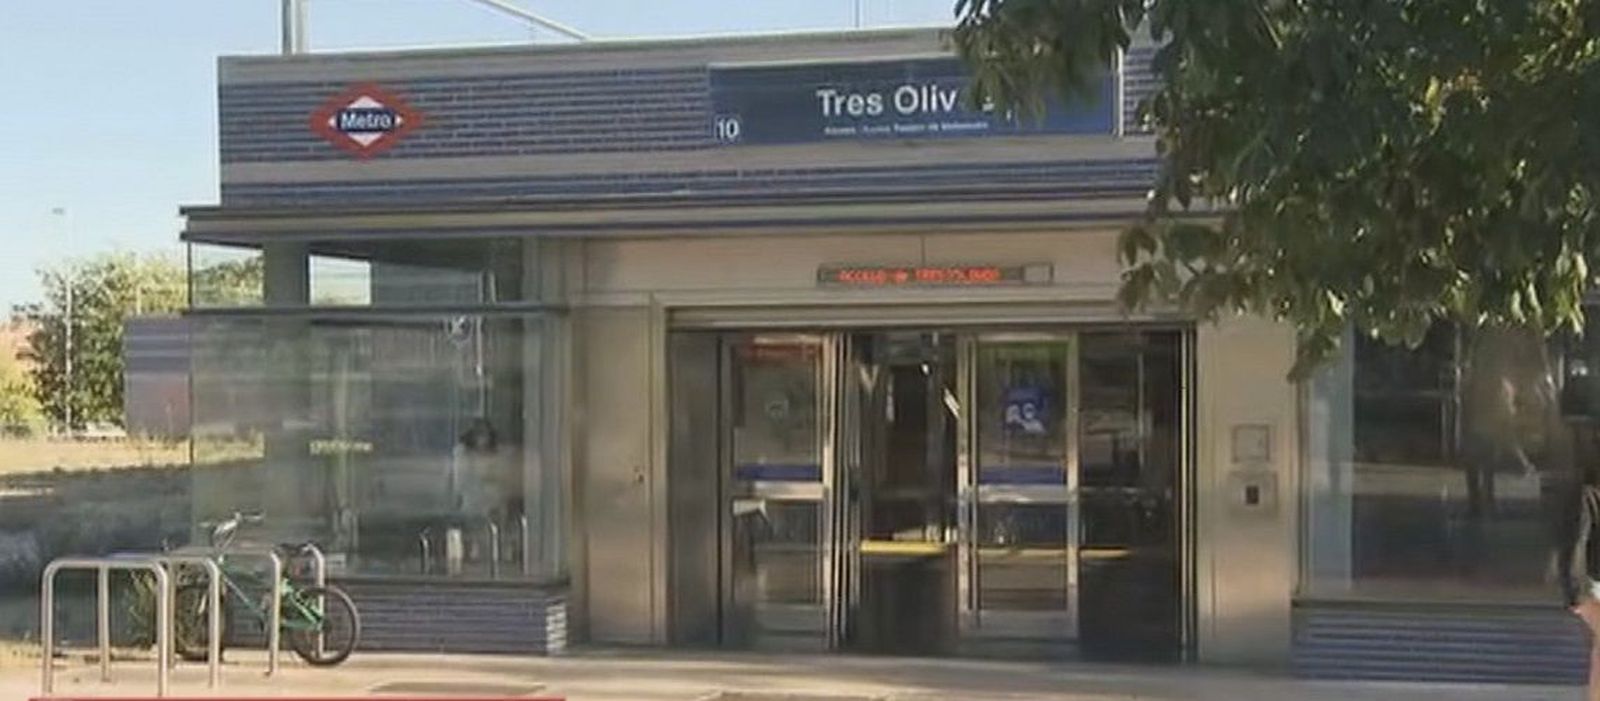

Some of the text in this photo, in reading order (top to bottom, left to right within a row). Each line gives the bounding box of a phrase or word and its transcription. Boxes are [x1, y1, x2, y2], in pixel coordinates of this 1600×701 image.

[816, 89, 883, 116] Tres
[341, 111, 392, 130] Metro
[718, 118, 740, 139] 10
